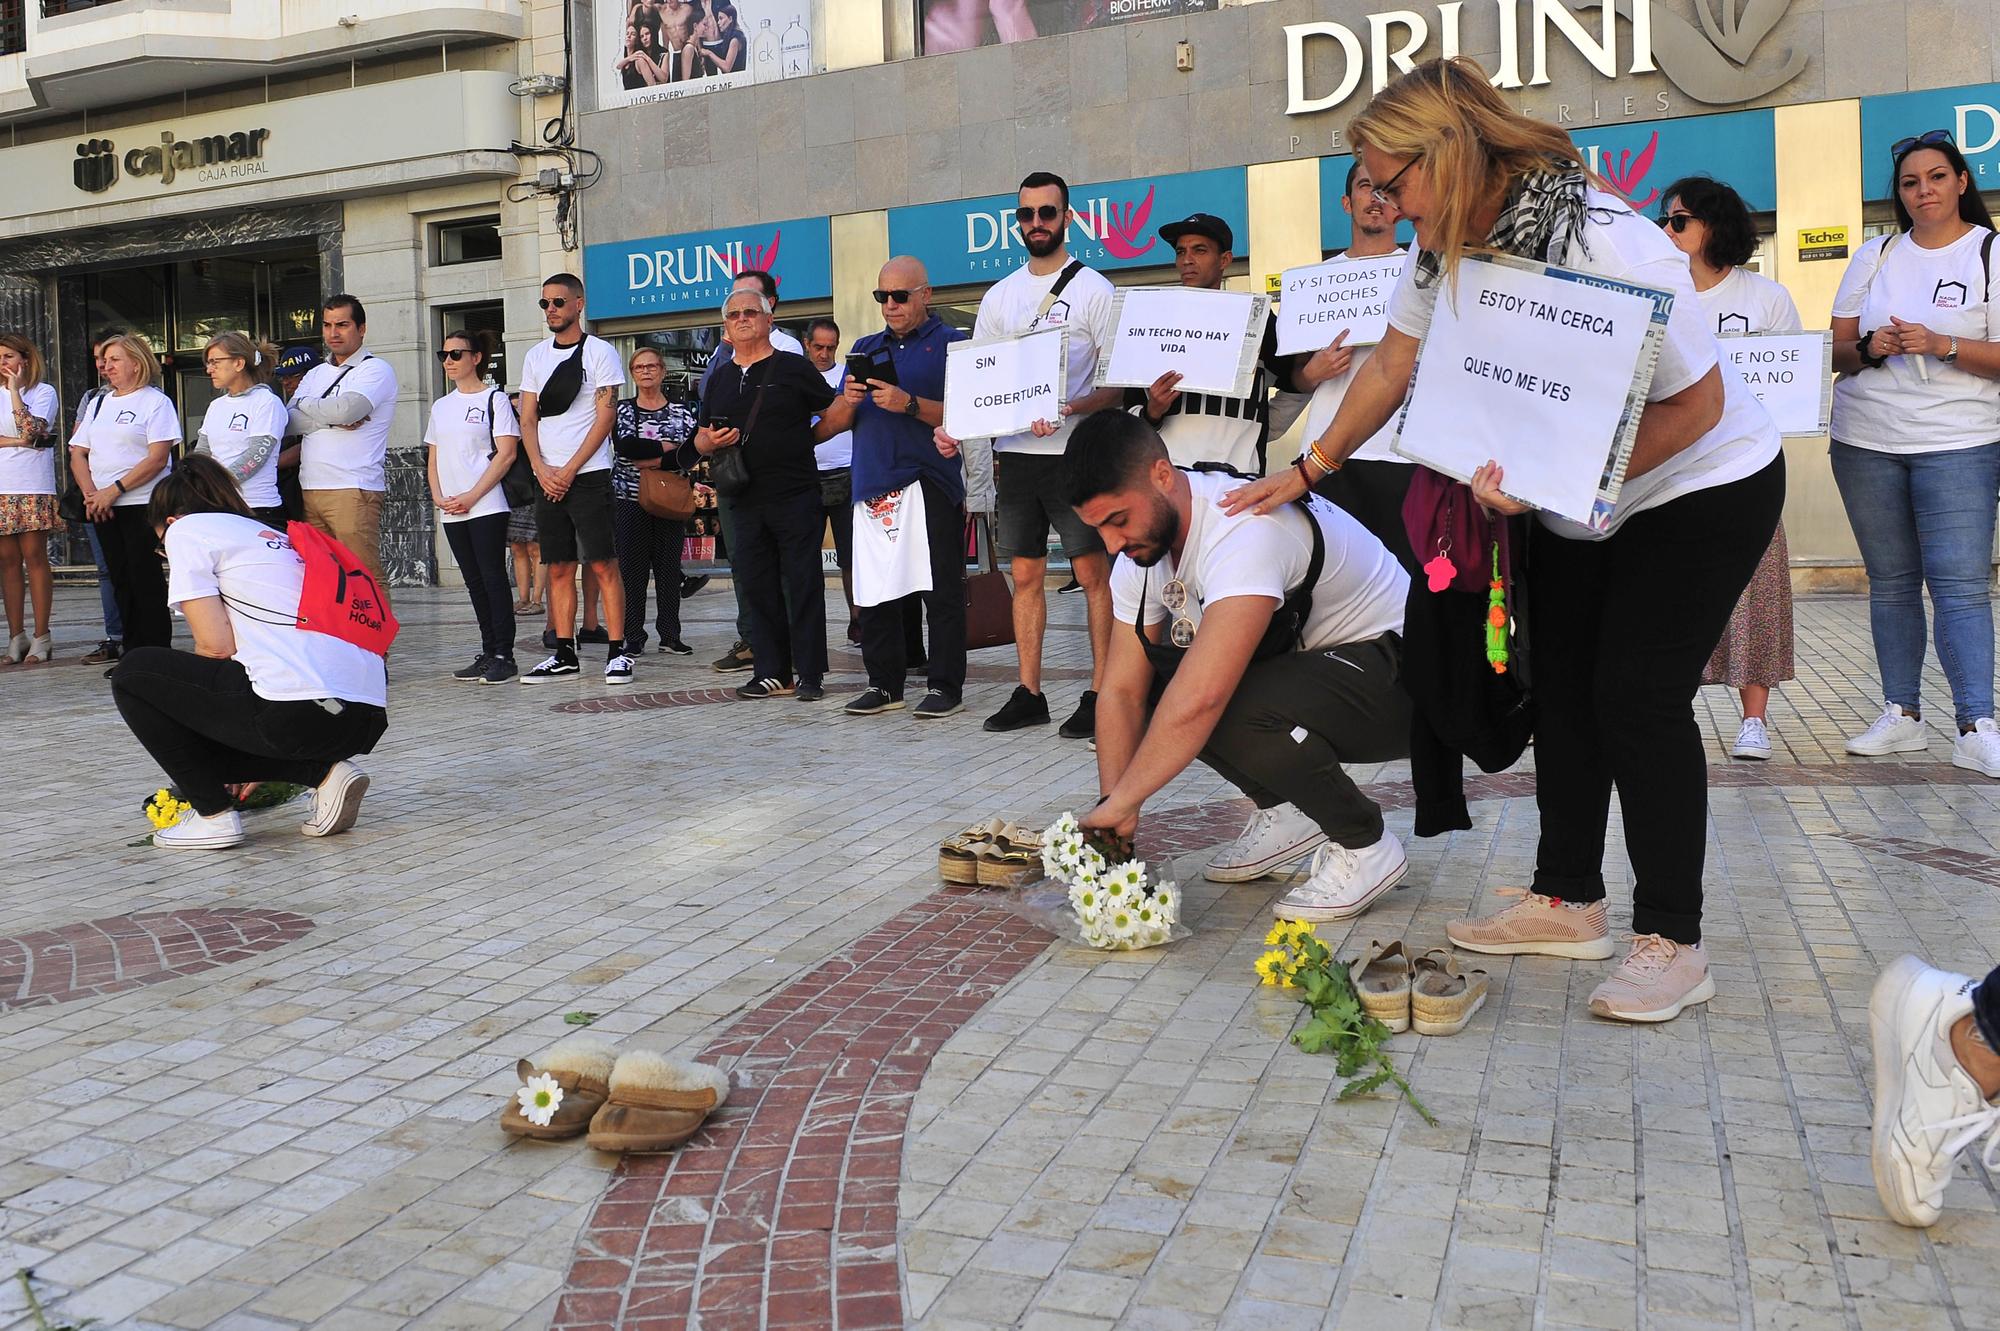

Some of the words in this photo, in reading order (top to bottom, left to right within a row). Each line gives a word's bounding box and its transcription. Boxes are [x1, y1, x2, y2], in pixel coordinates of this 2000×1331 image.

[1282, 0, 1657, 115] DRUNI
[124, 127, 270, 185] cajamar
[199, 168, 228, 183] CAJA
[230, 161, 269, 178] RURAL
[965, 197, 1110, 254] DRNI
[627, 240, 744, 290] DRUNI
[1289, 278, 1308, 292] ¿Y
[1310, 277, 1323, 288] SI
[1327, 269, 1378, 285] TODAS
[1382, 266, 1402, 278] TU
[1317, 286, 1378, 305] NOCHES
[1298, 307, 1358, 325] FUERAN
[1362, 300, 1388, 317] ASÍ
[1479, 289, 1526, 314] ESTOY
[1529, 301, 1558, 323] TAN
[1560, 309, 1614, 337] CERCA
[1128, 328, 1146, 337] SIN
[1148, 327, 1182, 338] TECHO
[1184, 329, 1203, 339] NO
[1205, 331, 1230, 341] HAY
[1160, 343, 1186, 354] VIDA
[1749, 350, 1775, 363] NO
[1780, 349, 1800, 362] SE
[975, 355, 996, 369] SIN
[1463, 356, 1491, 378] QUE
[1491, 365, 1513, 384] NO
[1514, 372, 1539, 392] ME
[1541, 379, 1571, 402] VES
[1767, 370, 1794, 384] NO
[974, 383, 1052, 409] COBERTURA
